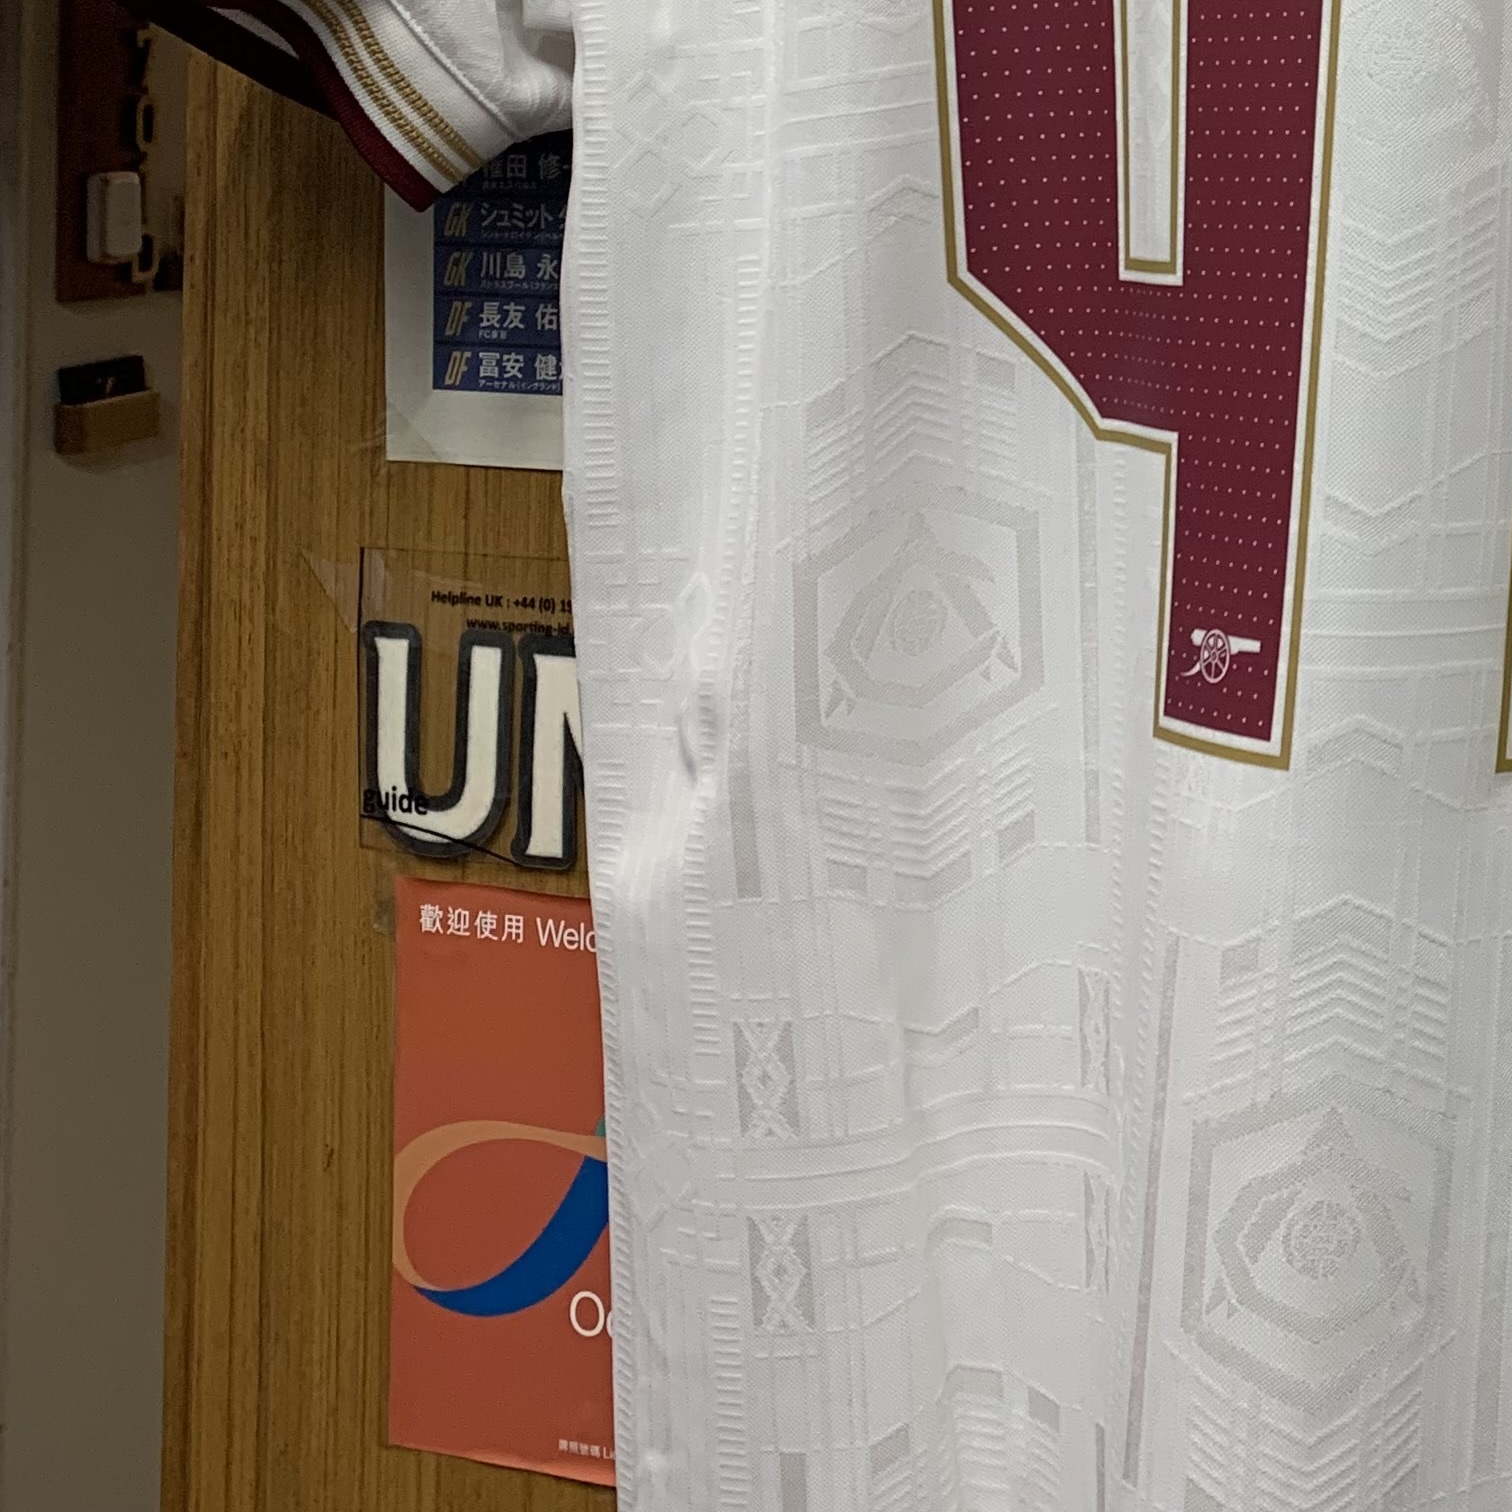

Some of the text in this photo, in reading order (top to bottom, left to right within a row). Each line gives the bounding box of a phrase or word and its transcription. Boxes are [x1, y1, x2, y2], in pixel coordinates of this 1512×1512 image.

[480, 252, 526, 281] 川島
[479, 302, 525, 329] 長友
[444, 351, 473, 385] DF
[431, 590, 482, 606] Helpline
[486, 594, 503, 607] UK
[513, 596, 536, 609] +44
[539, 597, 556, 614] (0)
[419, 903, 525, 944] 歡迎使用
